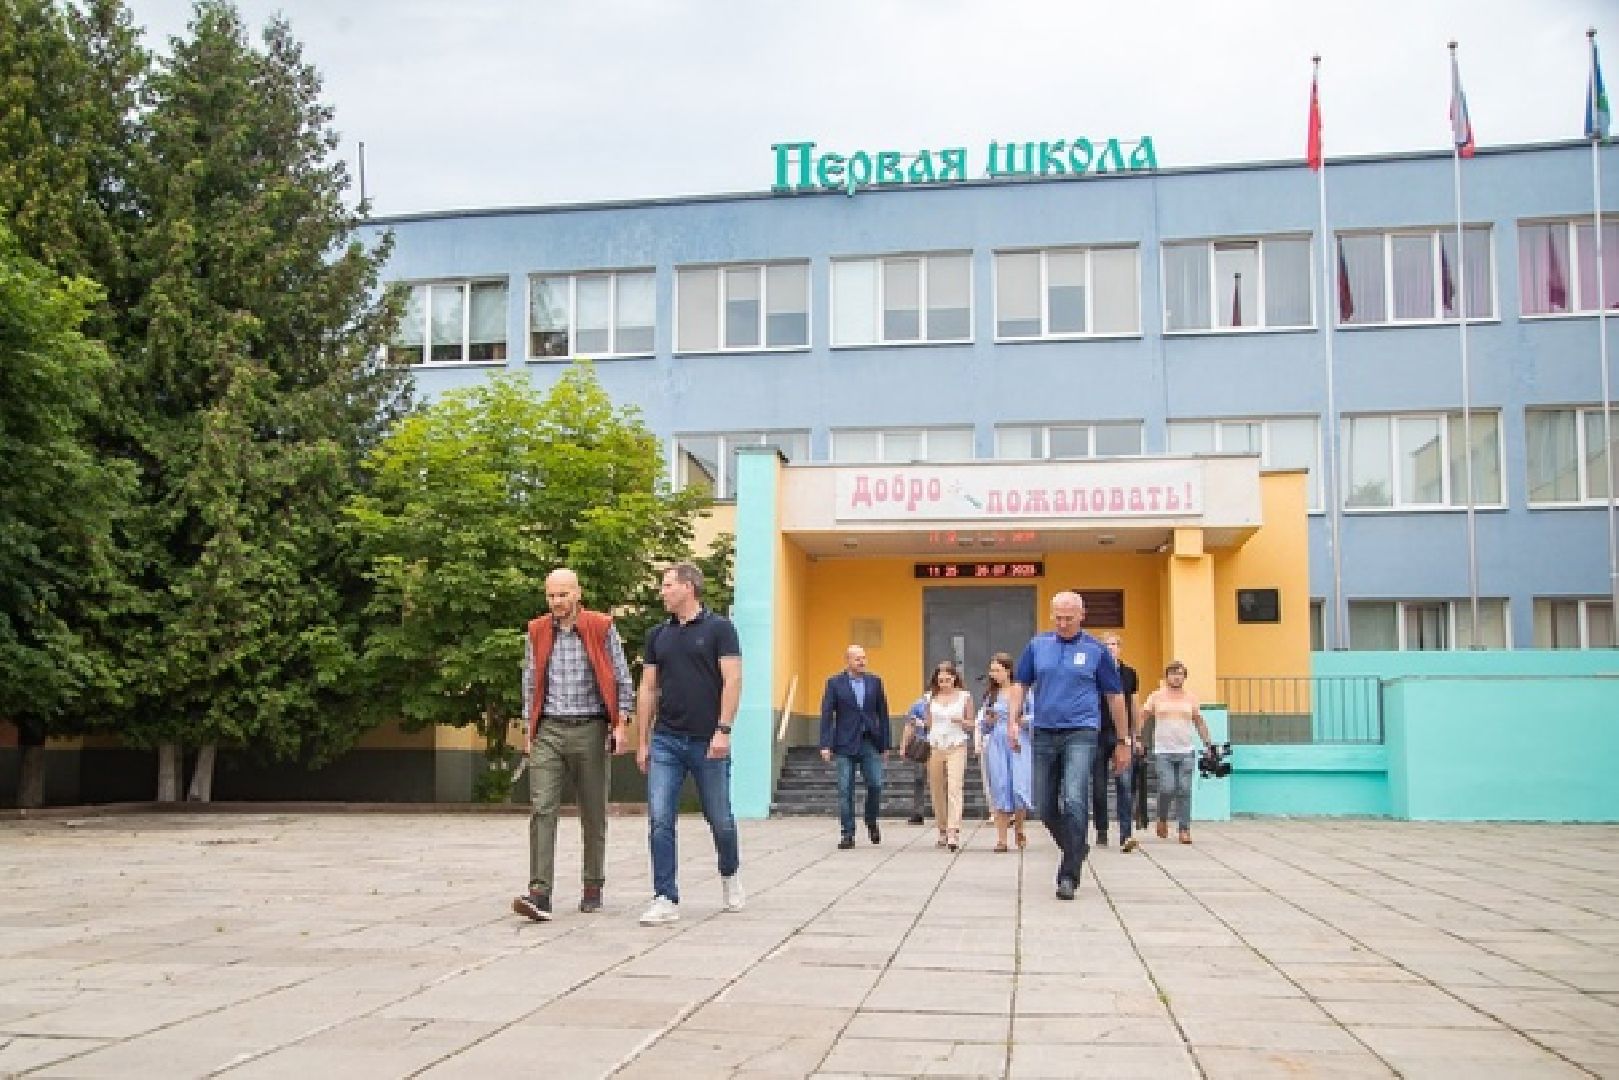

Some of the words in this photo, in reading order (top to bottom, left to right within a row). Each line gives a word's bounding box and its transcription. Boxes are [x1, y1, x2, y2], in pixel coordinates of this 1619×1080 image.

[771, 141, 968, 198] Первая
[851, 473, 942, 512] Добро
[986, 481, 1194, 514] пожаловать!
